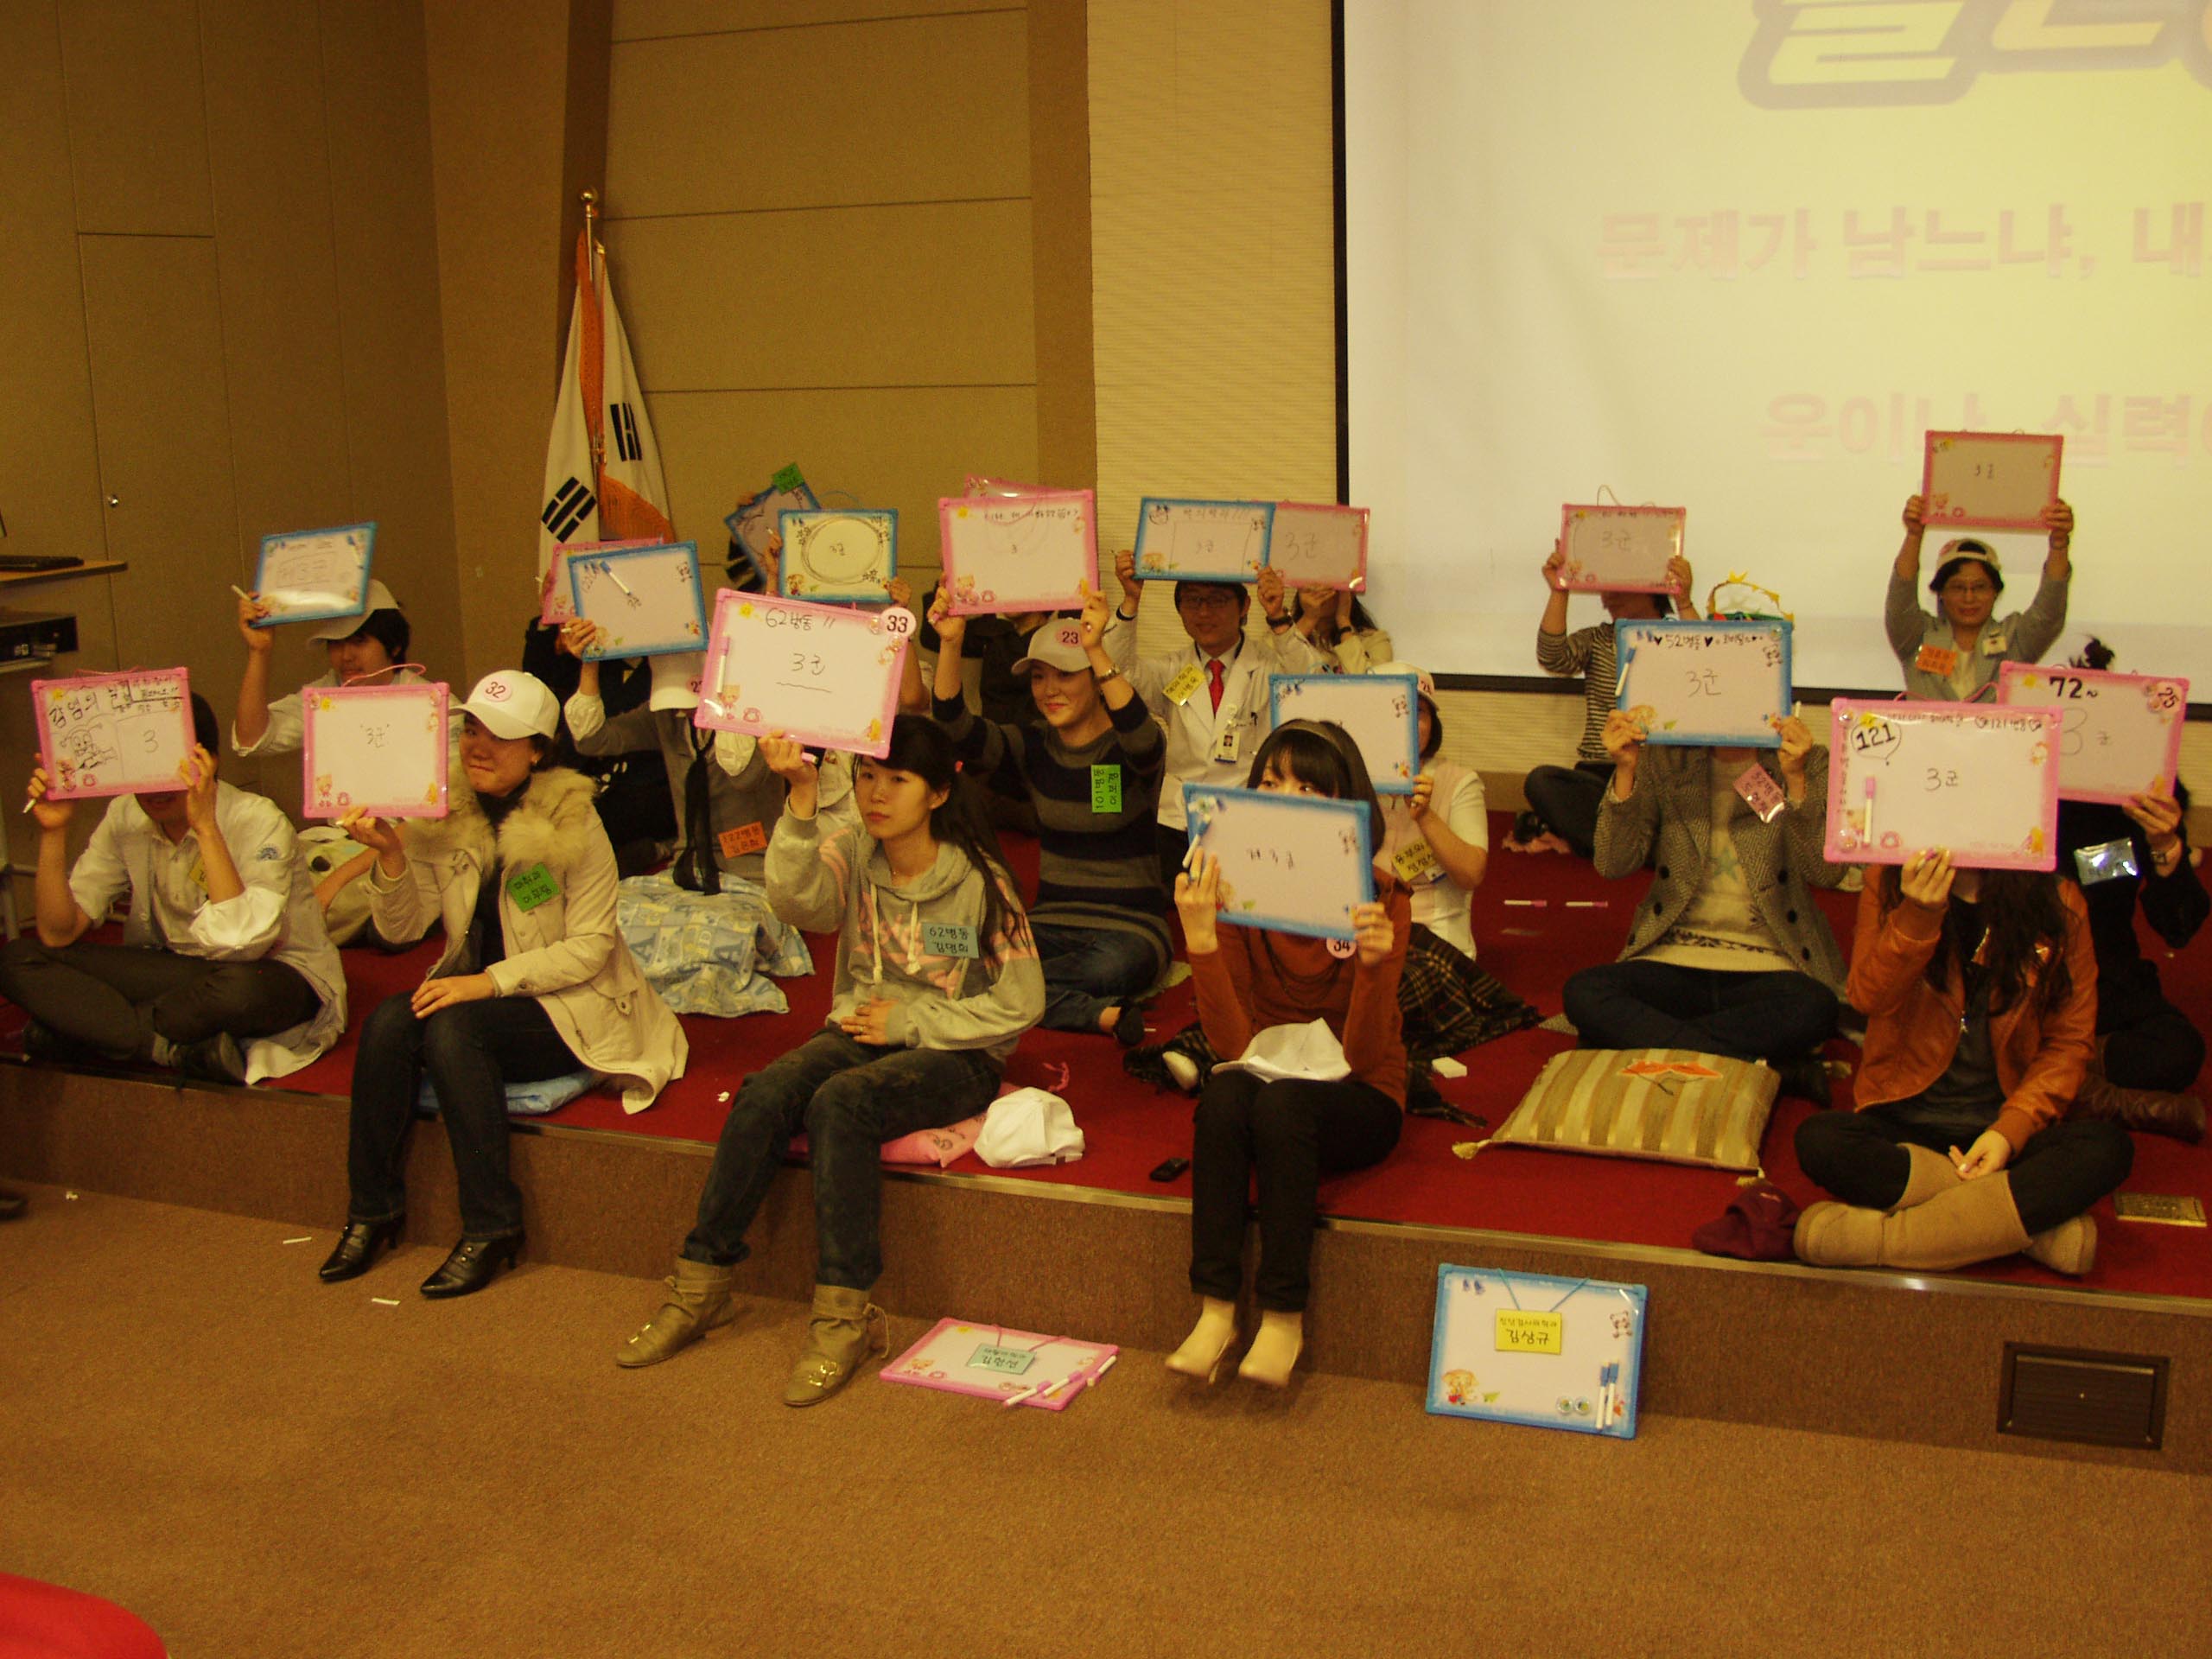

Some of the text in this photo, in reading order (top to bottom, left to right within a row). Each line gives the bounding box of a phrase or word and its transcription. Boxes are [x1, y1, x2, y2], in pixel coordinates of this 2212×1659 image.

[1595, 207, 1818, 282] 문제가
[1842, 202, 2096, 281] 남느냐,
[1284, 531, 1322, 562] 3군
[886, 614, 908, 633] 33
[1061, 630, 1079, 645] 23
[791, 652, 826, 677] 3군
[485, 680, 506, 699] 32
[1686, 668, 1723, 698] 3군
[49, 690, 100, 729] 감염의
[2157, 687, 2180, 709] 25
[143, 729, 160, 754] 3
[1855, 723, 1897, 751] 121
[1094, 768, 1105, 809] 101병동
[1923, 767, 1959, 792] 3군
[929, 926, 969, 940] 62병동
[1506, 1329, 1548, 1345] 김상규
